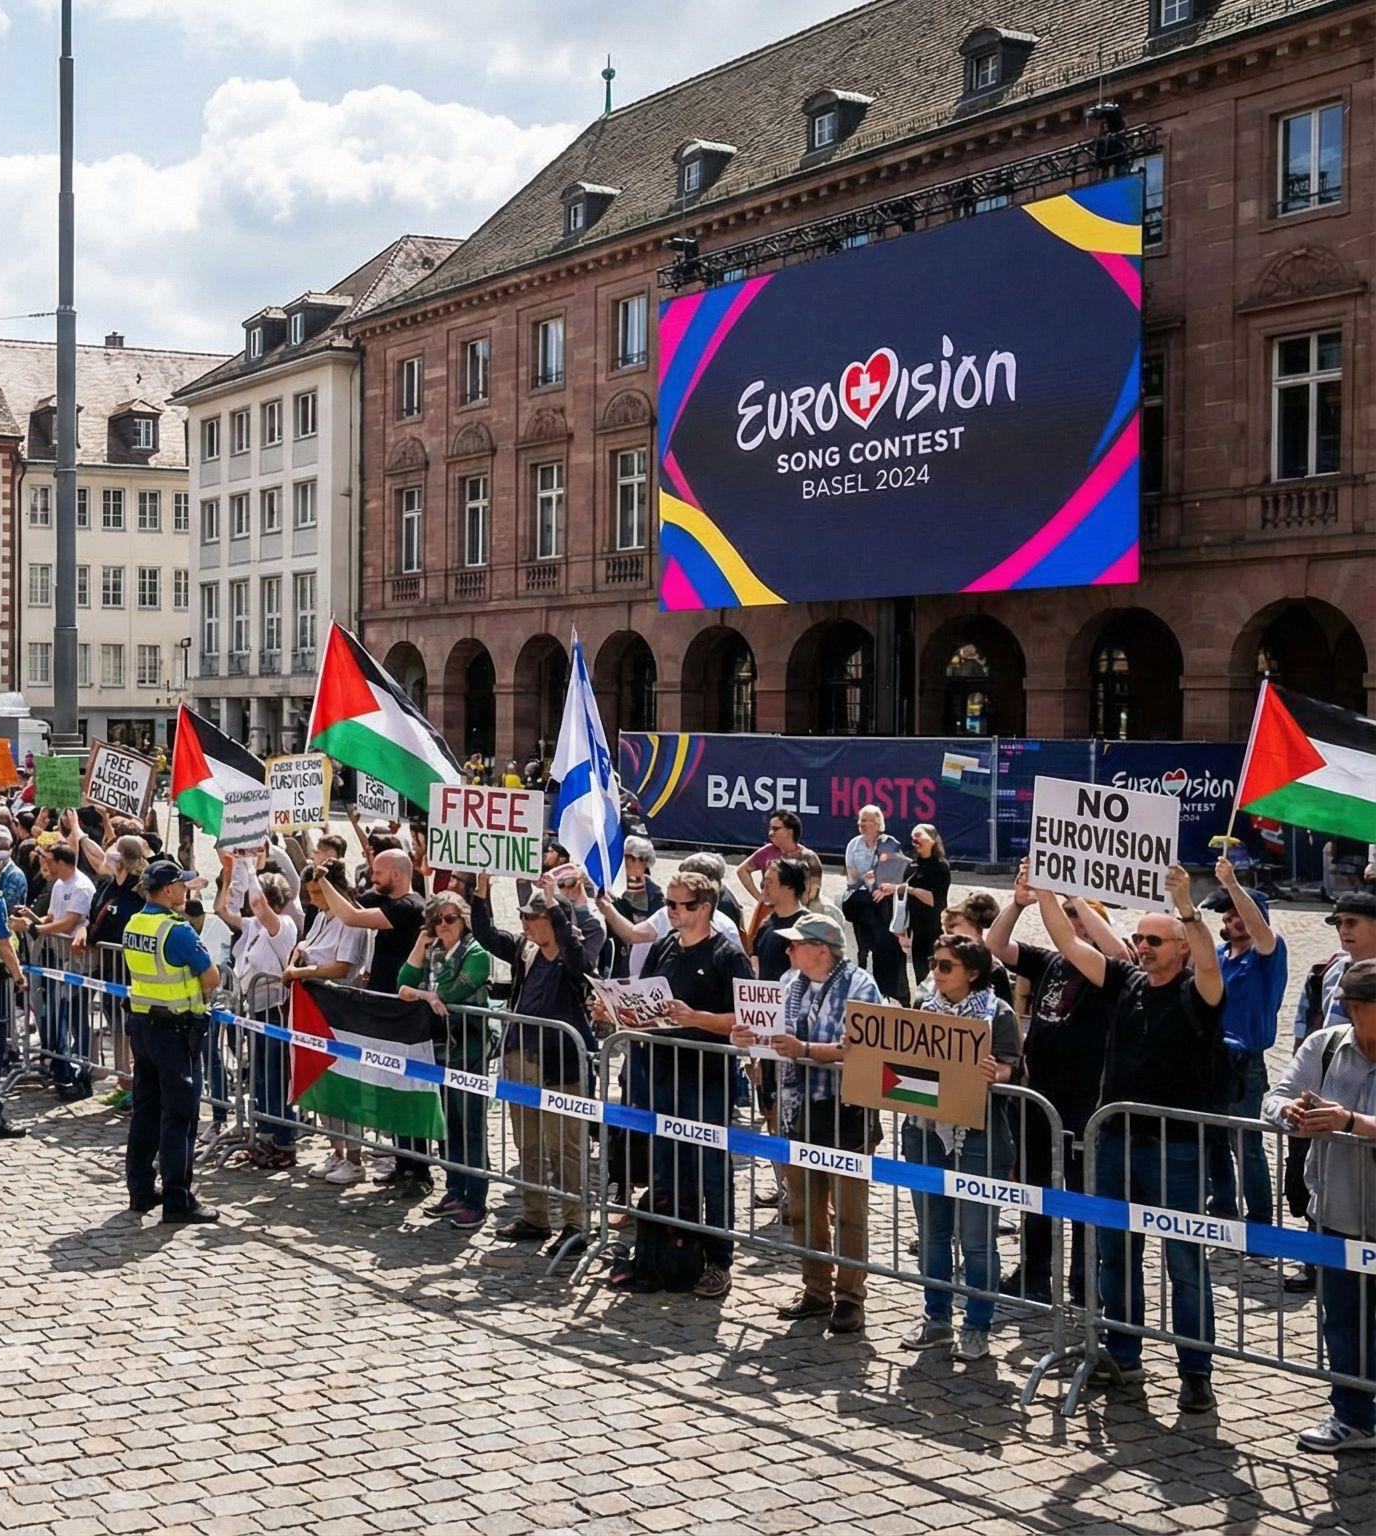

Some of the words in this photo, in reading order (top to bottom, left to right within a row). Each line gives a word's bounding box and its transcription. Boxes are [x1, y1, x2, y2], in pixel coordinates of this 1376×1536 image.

[777, 446, 841, 474] SONG
[849, 426, 965, 464] CONTEST
[802, 473, 870, 500] BASEL
[876, 464, 930, 490] 2024
[294, 791, 305, 806] IS
[441, 788, 530, 833] FREE
[707, 774, 820, 815] BASEL
[831, 776, 936, 821] HOSTS
[1077, 788, 1129, 823] NO
[1179, 803, 1216, 812] NTEST
[429, 827, 539, 874] PALESTINE
[1035, 815, 1172, 867] EUROVISION
[1035, 849, 1077, 884] FOR
[1083, 858, 1165, 902] ISRAEL
[740, 1008, 777, 1028] WAY
[849, 1013, 986, 1066] SOLIDARITY
[955, 1178, 1025, 1205] POLIZEI
[1142, 1211, 1225, 1241] POLIZEI
